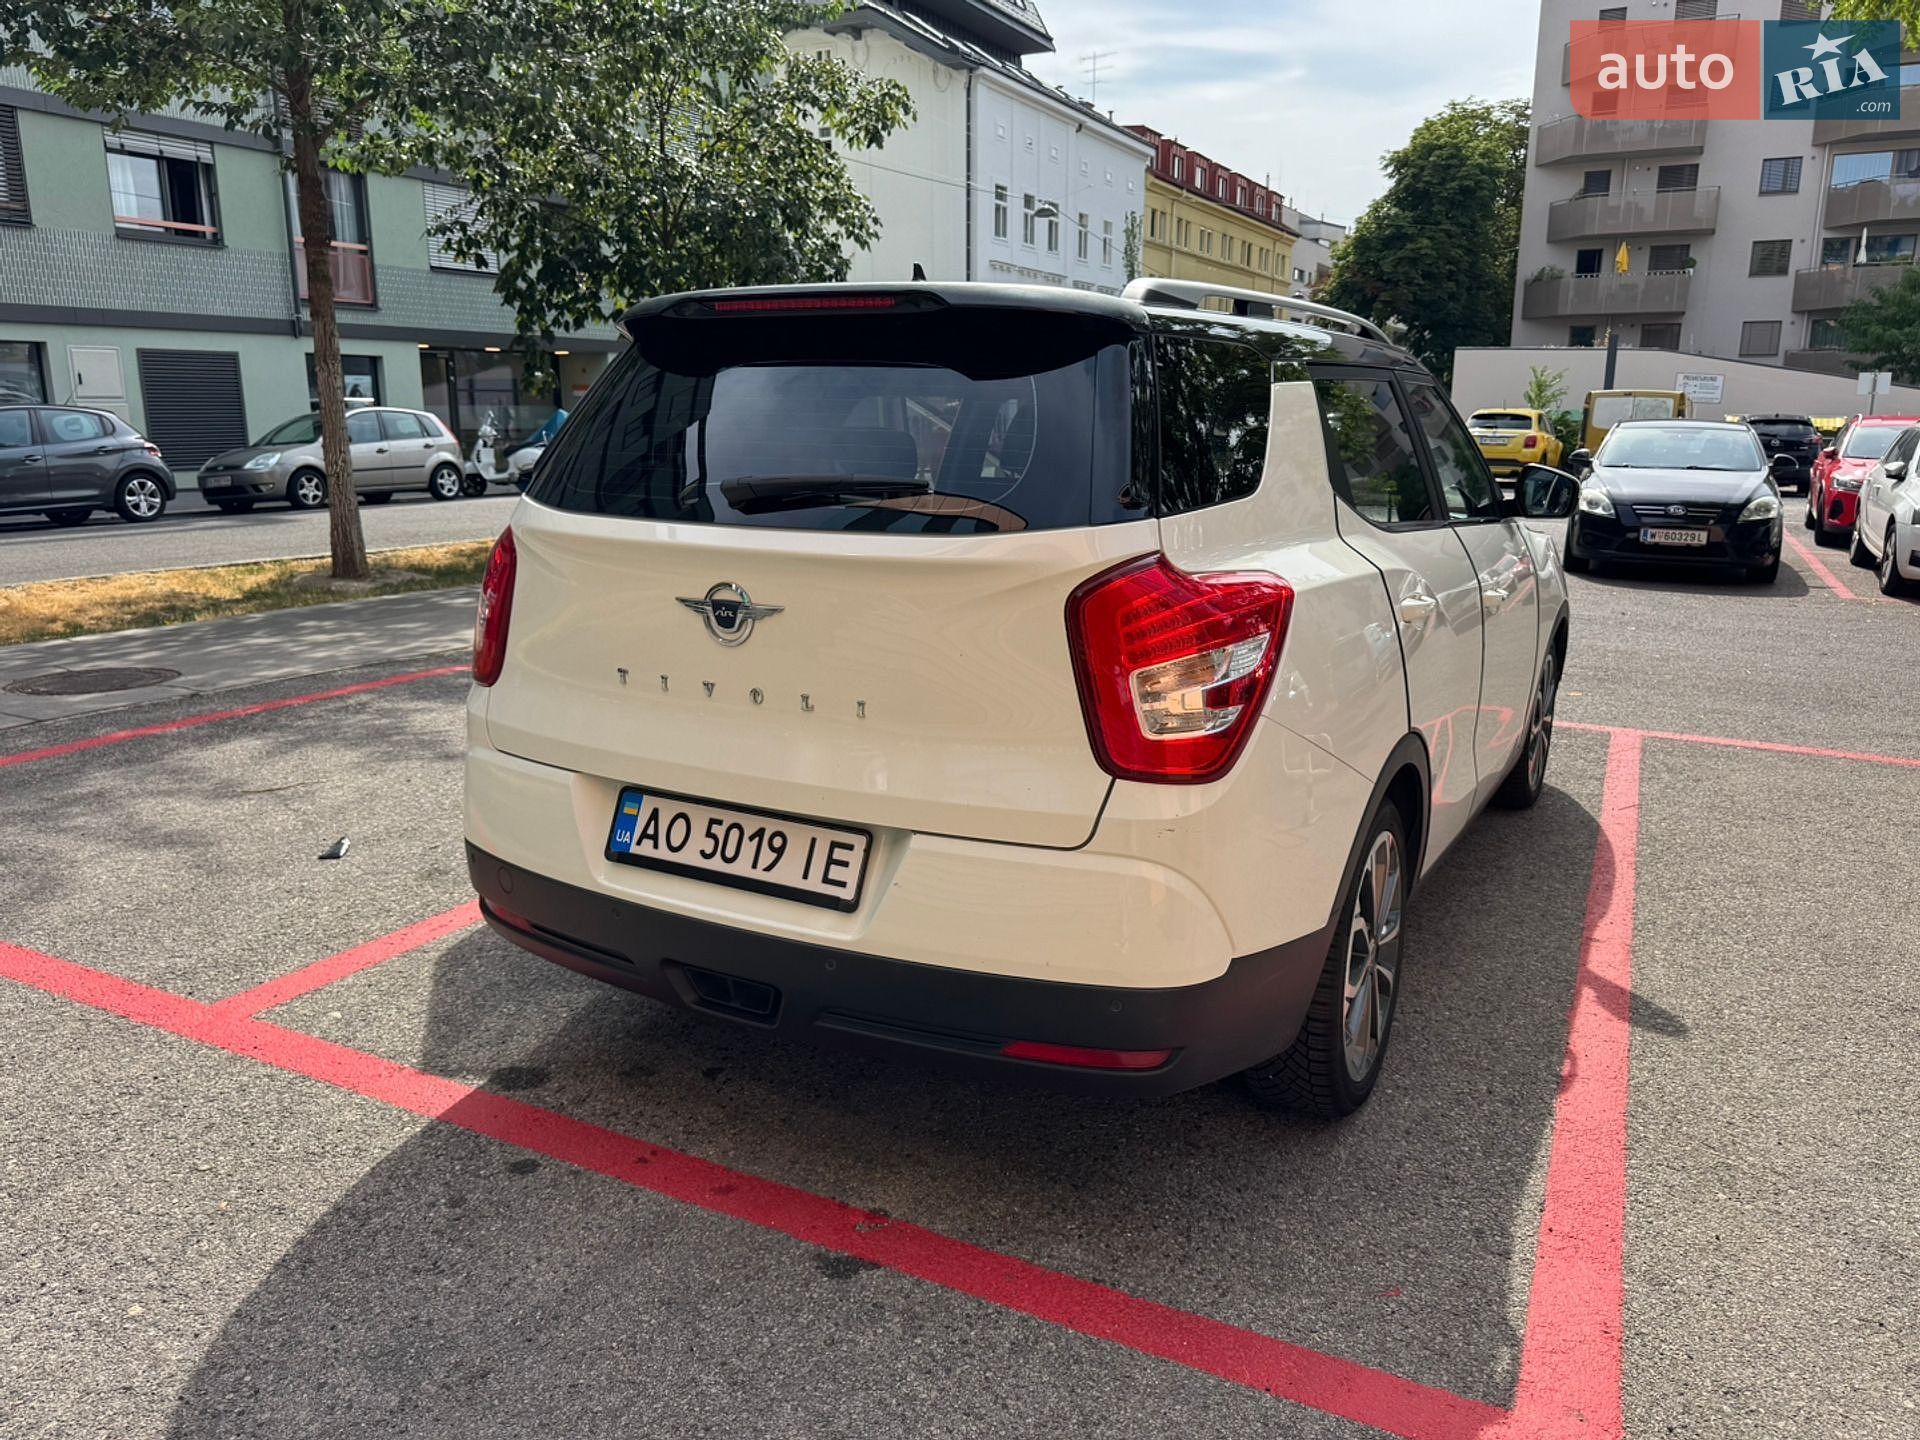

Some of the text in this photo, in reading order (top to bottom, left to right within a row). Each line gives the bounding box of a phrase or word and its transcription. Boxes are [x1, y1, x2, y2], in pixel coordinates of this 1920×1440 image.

[617, 667, 867, 719] TIVOLI
[615, 828, 632, 844] UA
[635, 807, 855, 888] AO 5019 IE
